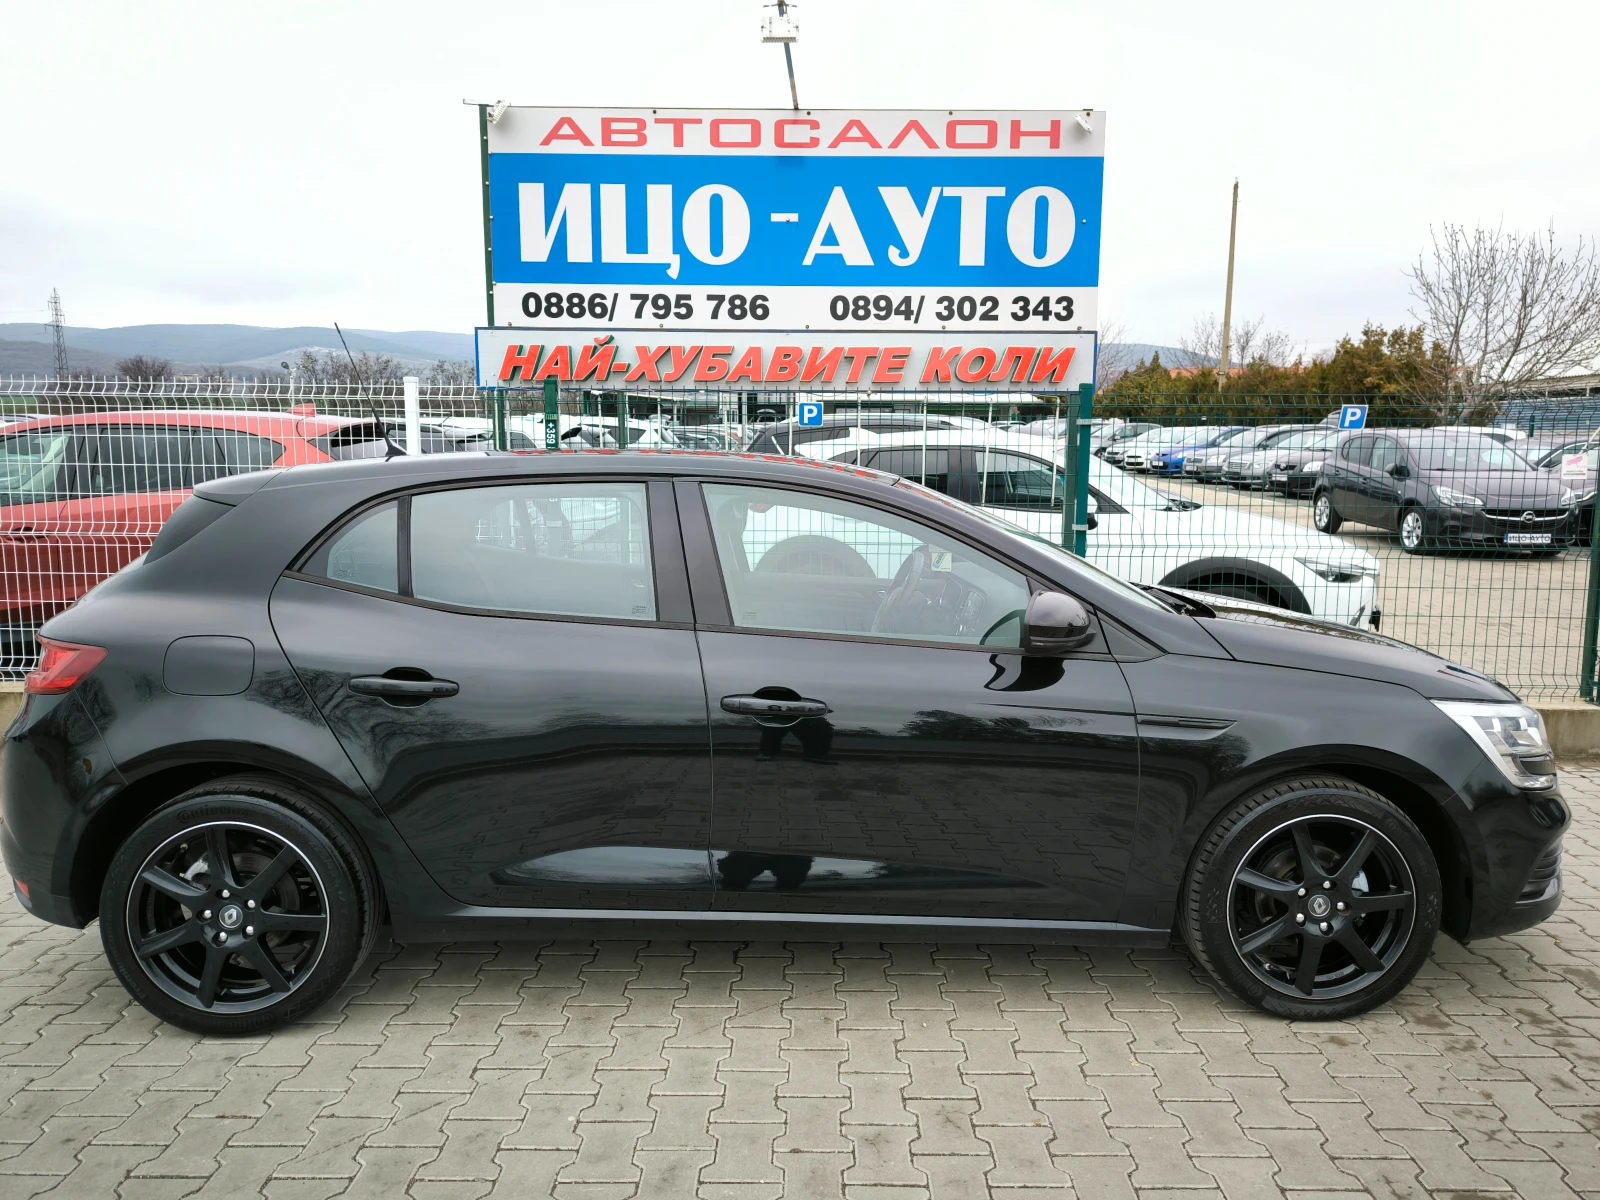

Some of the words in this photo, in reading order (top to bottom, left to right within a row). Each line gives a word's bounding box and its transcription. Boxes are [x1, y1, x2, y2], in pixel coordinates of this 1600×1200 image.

[541, 117, 1061, 149] АВТОСАЛОН
[522, 292, 618, 321] 0886/
[631, 294, 693, 319] 795
[707, 294, 769, 320] 786
[830, 295, 925, 323] 0894/
[936, 296, 999, 321] 302
[1011, 296, 1073, 321] 343
[499, 336, 910, 382] НАЙ-ХУБАВИТЕ
[922, 346, 1076, 383] КОЛИ
[546, 422, 556, 444] +359
